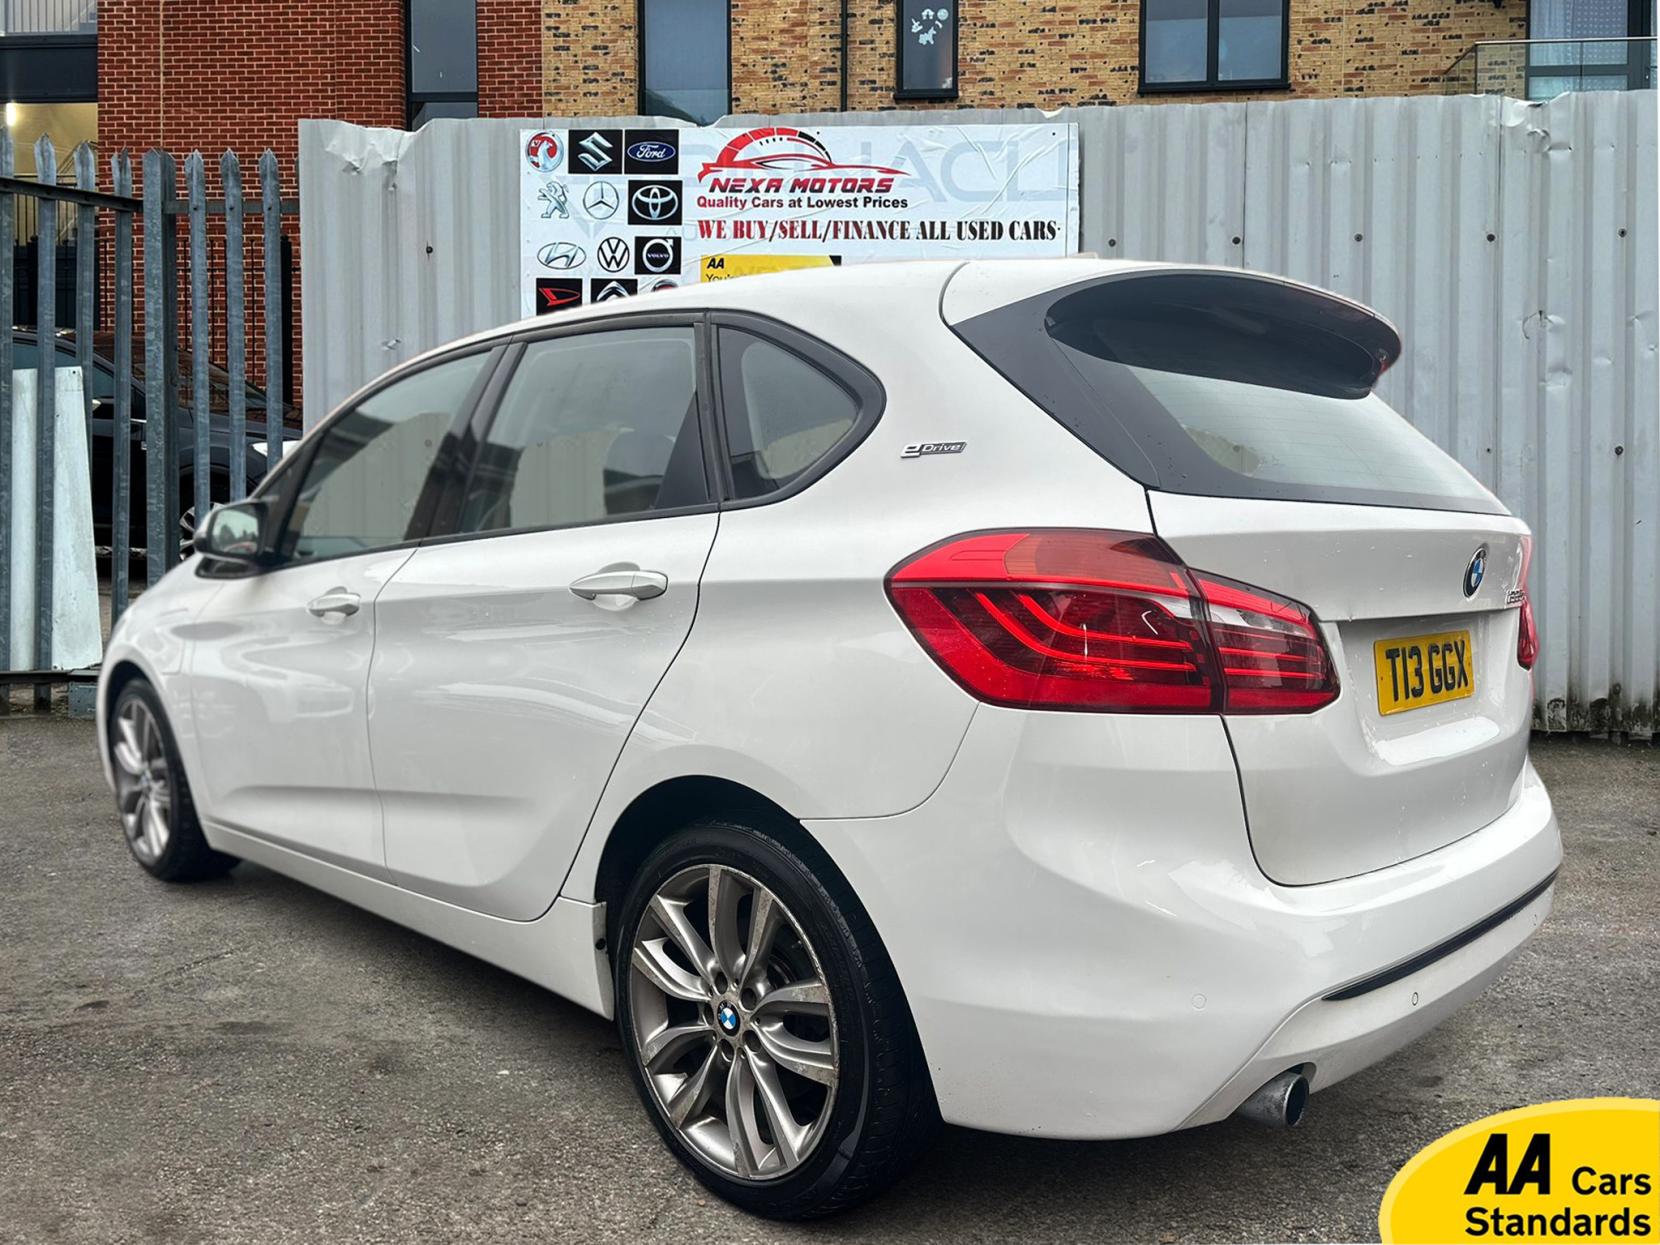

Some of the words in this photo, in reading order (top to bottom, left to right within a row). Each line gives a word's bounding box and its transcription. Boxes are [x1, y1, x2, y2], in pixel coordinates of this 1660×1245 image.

[636, 145, 666, 159] Ford
[709, 178, 783, 193] NEXA
[789, 178, 894, 193] MOTORS
[697, 196, 747, 210] Quality
[751, 197, 784, 208] Cars
[789, 197, 803, 208] at
[808, 197, 859, 208] Lowest
[863, 196, 909, 208] Prices
[698, 220, 727, 239] WE
[734, 220, 911, 242] BUY/SELL/FINANCE
[916, 220, 951, 240] ALL
[957, 220, 1004, 240] USED
[1009, 220, 1057, 240] CARS
[707, 257, 724, 269] AA
[901, 443, 962, 458] eDrive
[1385, 645, 1425, 702] T13
[1428, 639, 1469, 694] GGX
